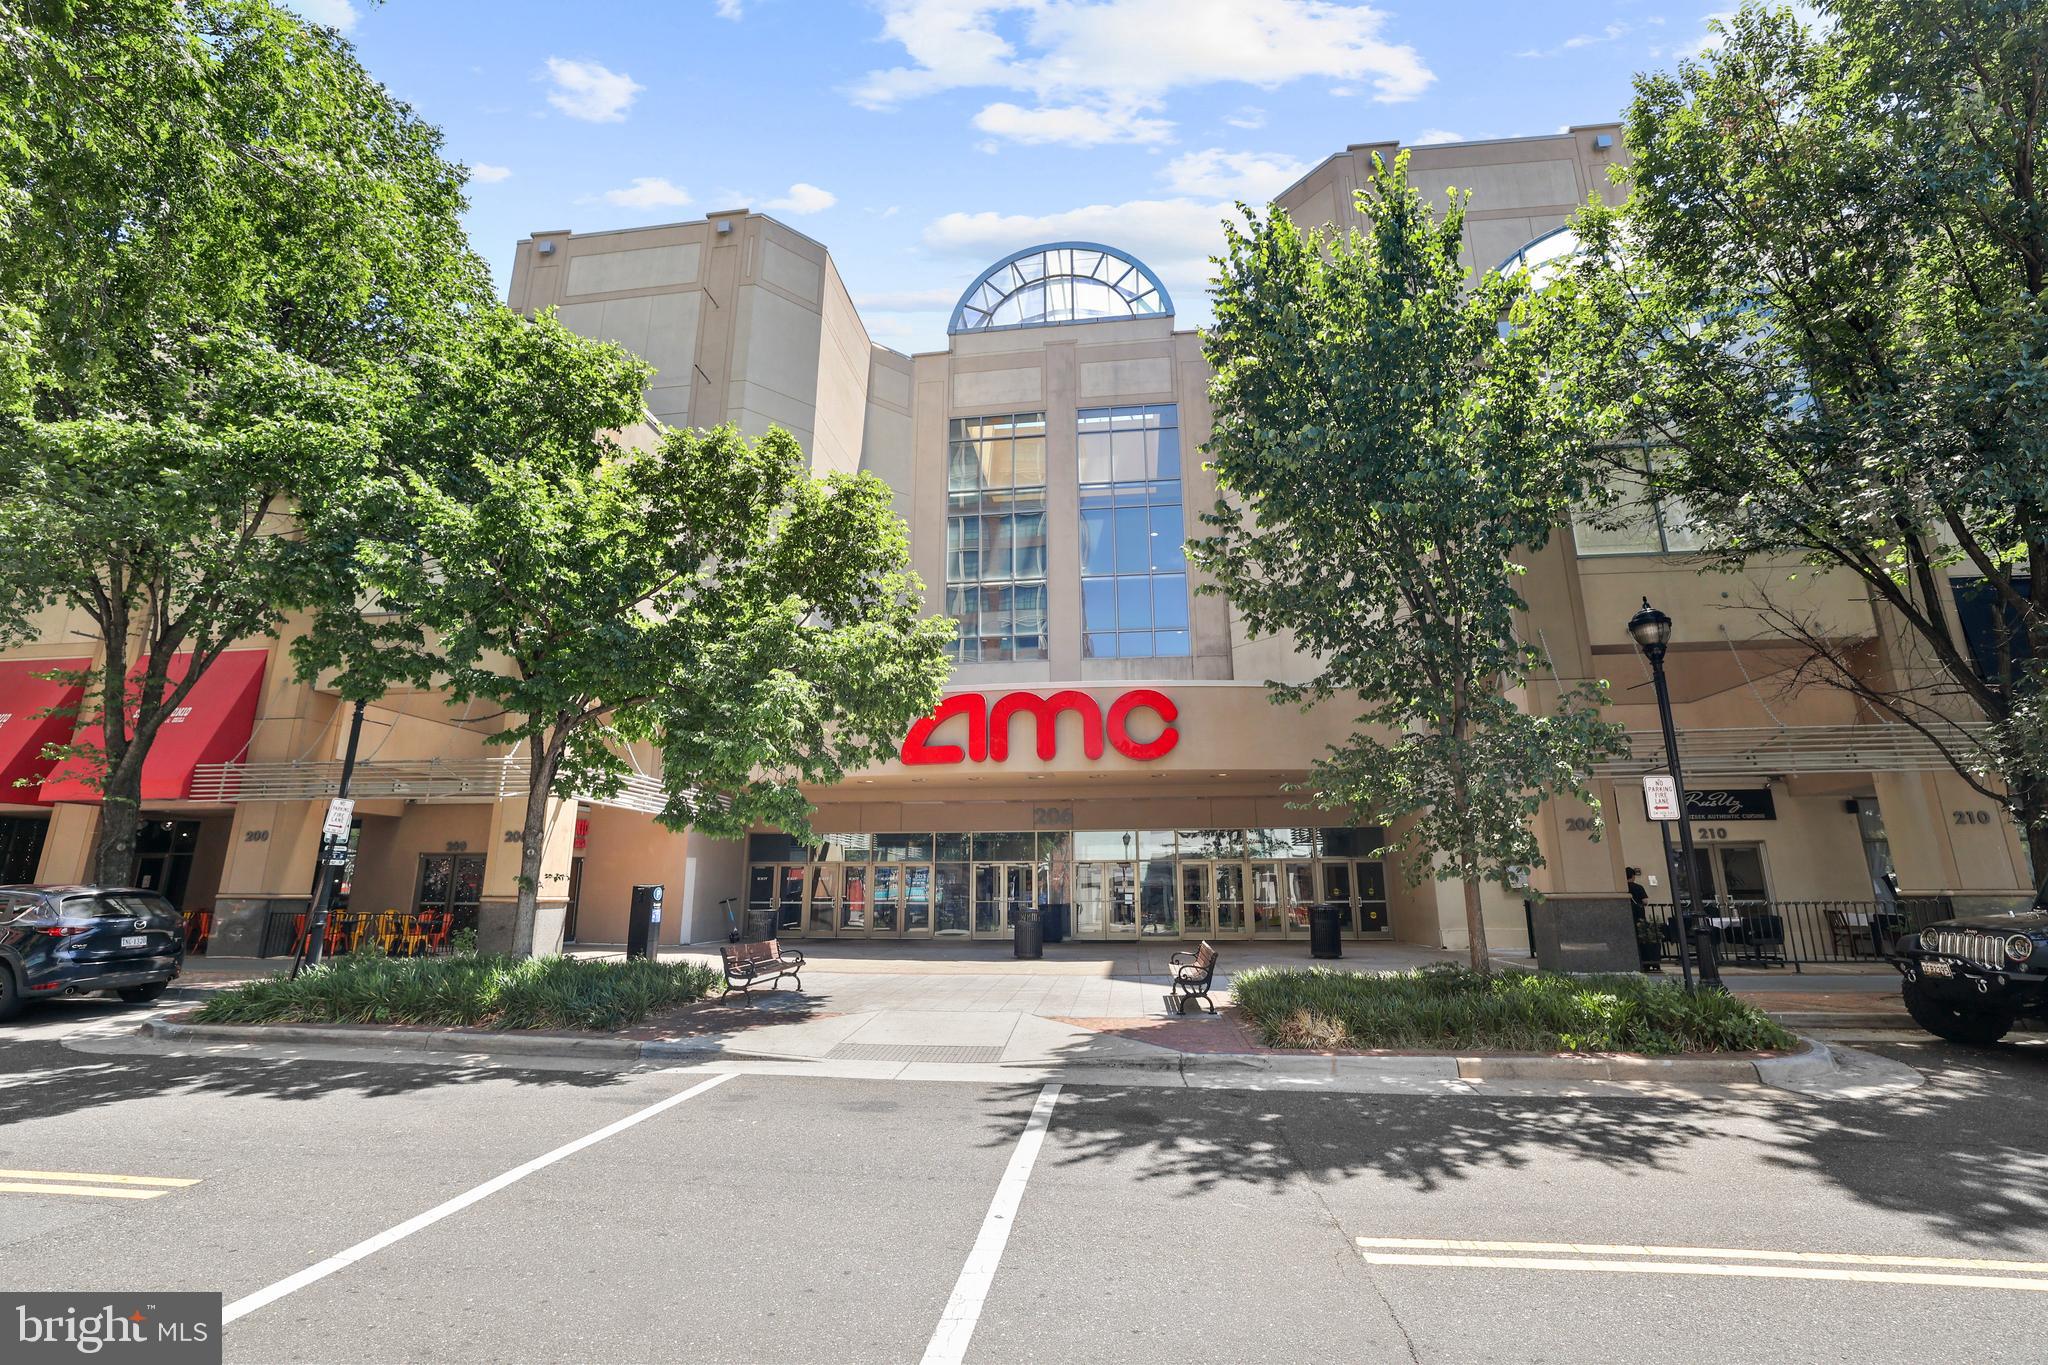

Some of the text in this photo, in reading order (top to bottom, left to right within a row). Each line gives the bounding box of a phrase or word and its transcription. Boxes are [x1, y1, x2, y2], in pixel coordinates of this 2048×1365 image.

[1034, 807, 1074, 825] 206
[1952, 810, 1991, 825] 210
[245, 830, 269, 842] 200
[1698, 828, 1727, 840] 210
